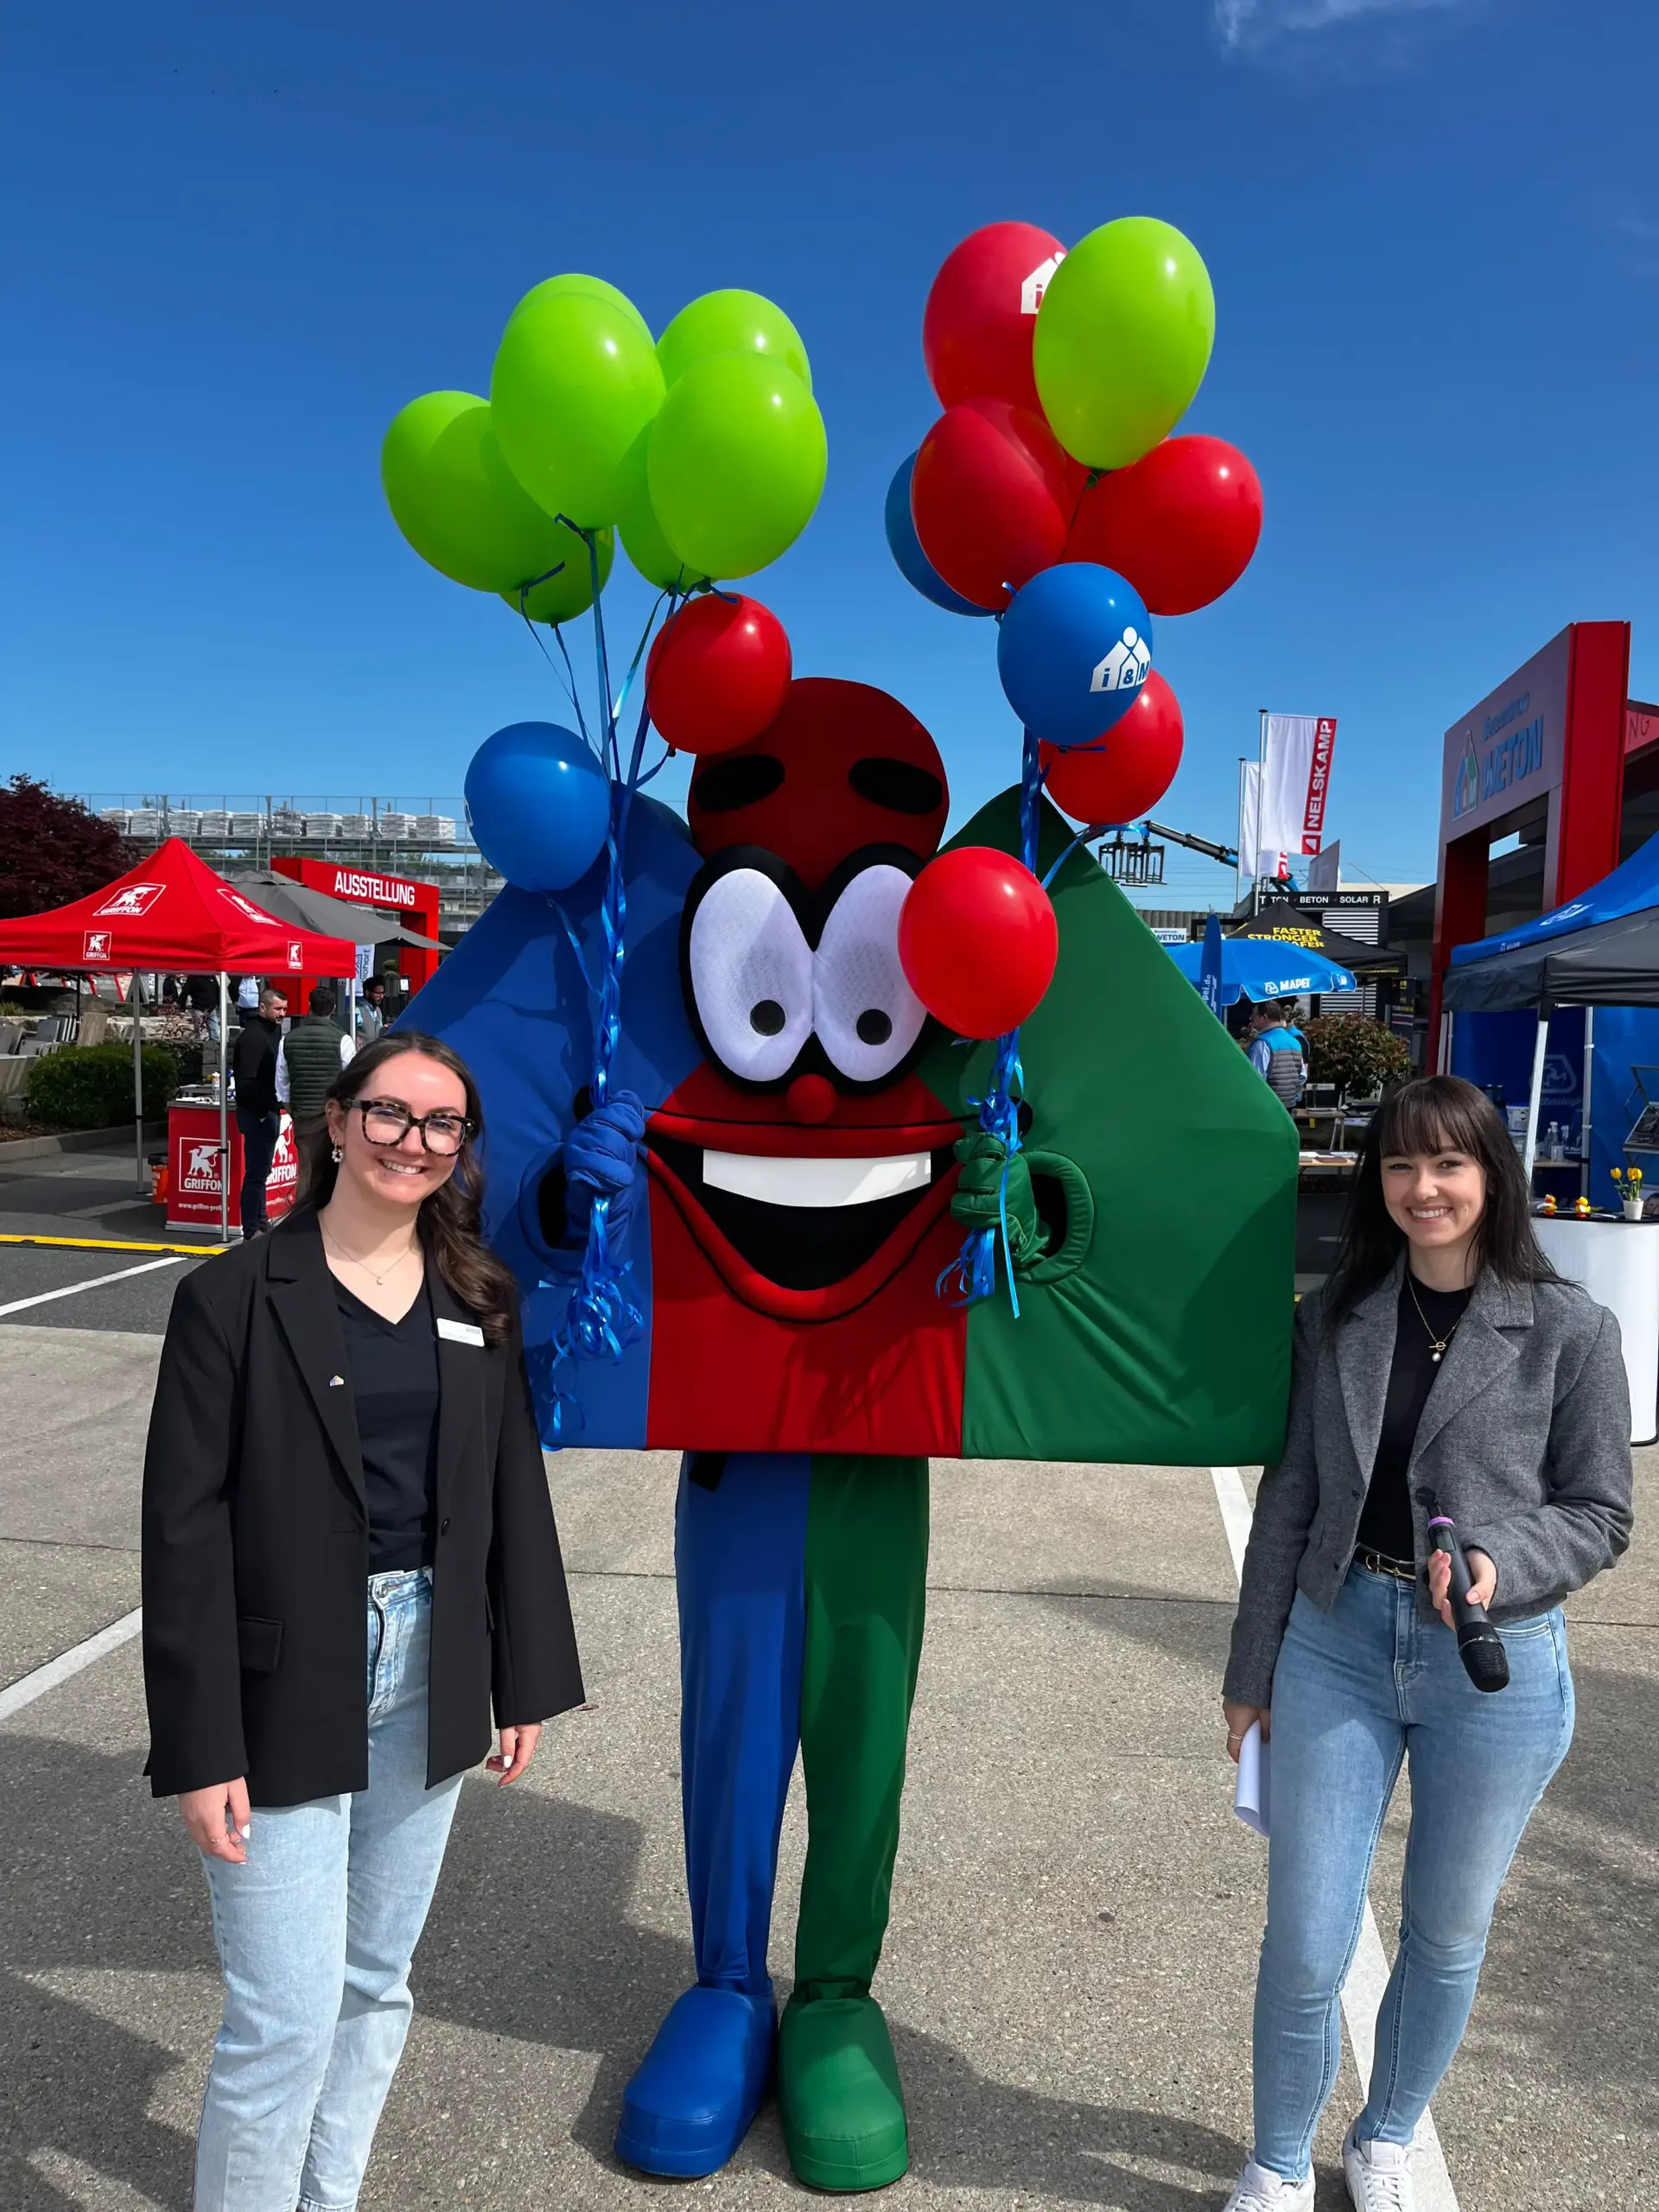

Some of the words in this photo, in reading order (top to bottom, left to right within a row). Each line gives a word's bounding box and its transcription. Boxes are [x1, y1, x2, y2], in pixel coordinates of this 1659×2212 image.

[1482, 713, 1544, 802] WETON
[1307, 720, 1332, 828] NELSKAMP
[334, 870, 415, 906] AUSSTELLUNG
[1247, 933, 1318, 942] STRONGER
[1273, 926, 1322, 937] FASTER
[1280, 977, 1311, 992] MAPEI
